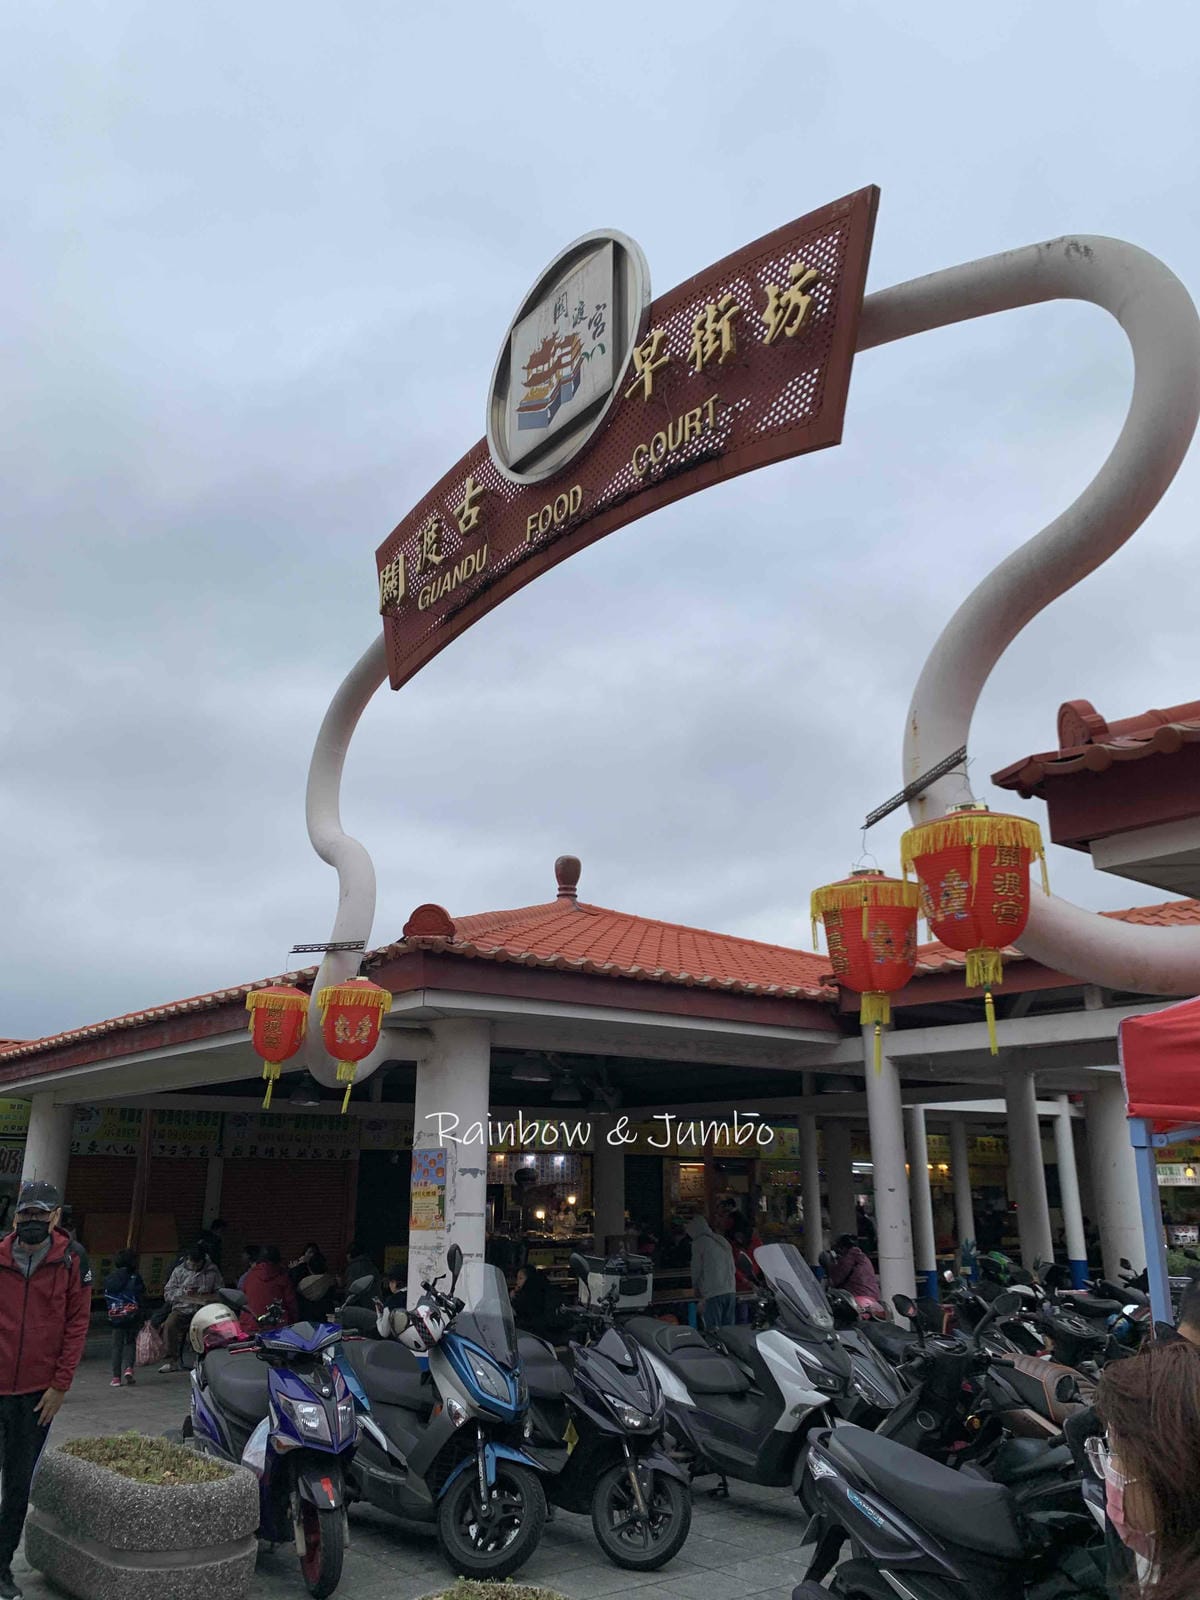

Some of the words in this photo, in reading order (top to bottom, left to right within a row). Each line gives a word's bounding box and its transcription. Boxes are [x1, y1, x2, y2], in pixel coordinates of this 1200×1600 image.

[417, 543, 488, 611] GUANDU
[526, 484, 583, 542] FOOD
[632, 393, 719, 477] COURT
